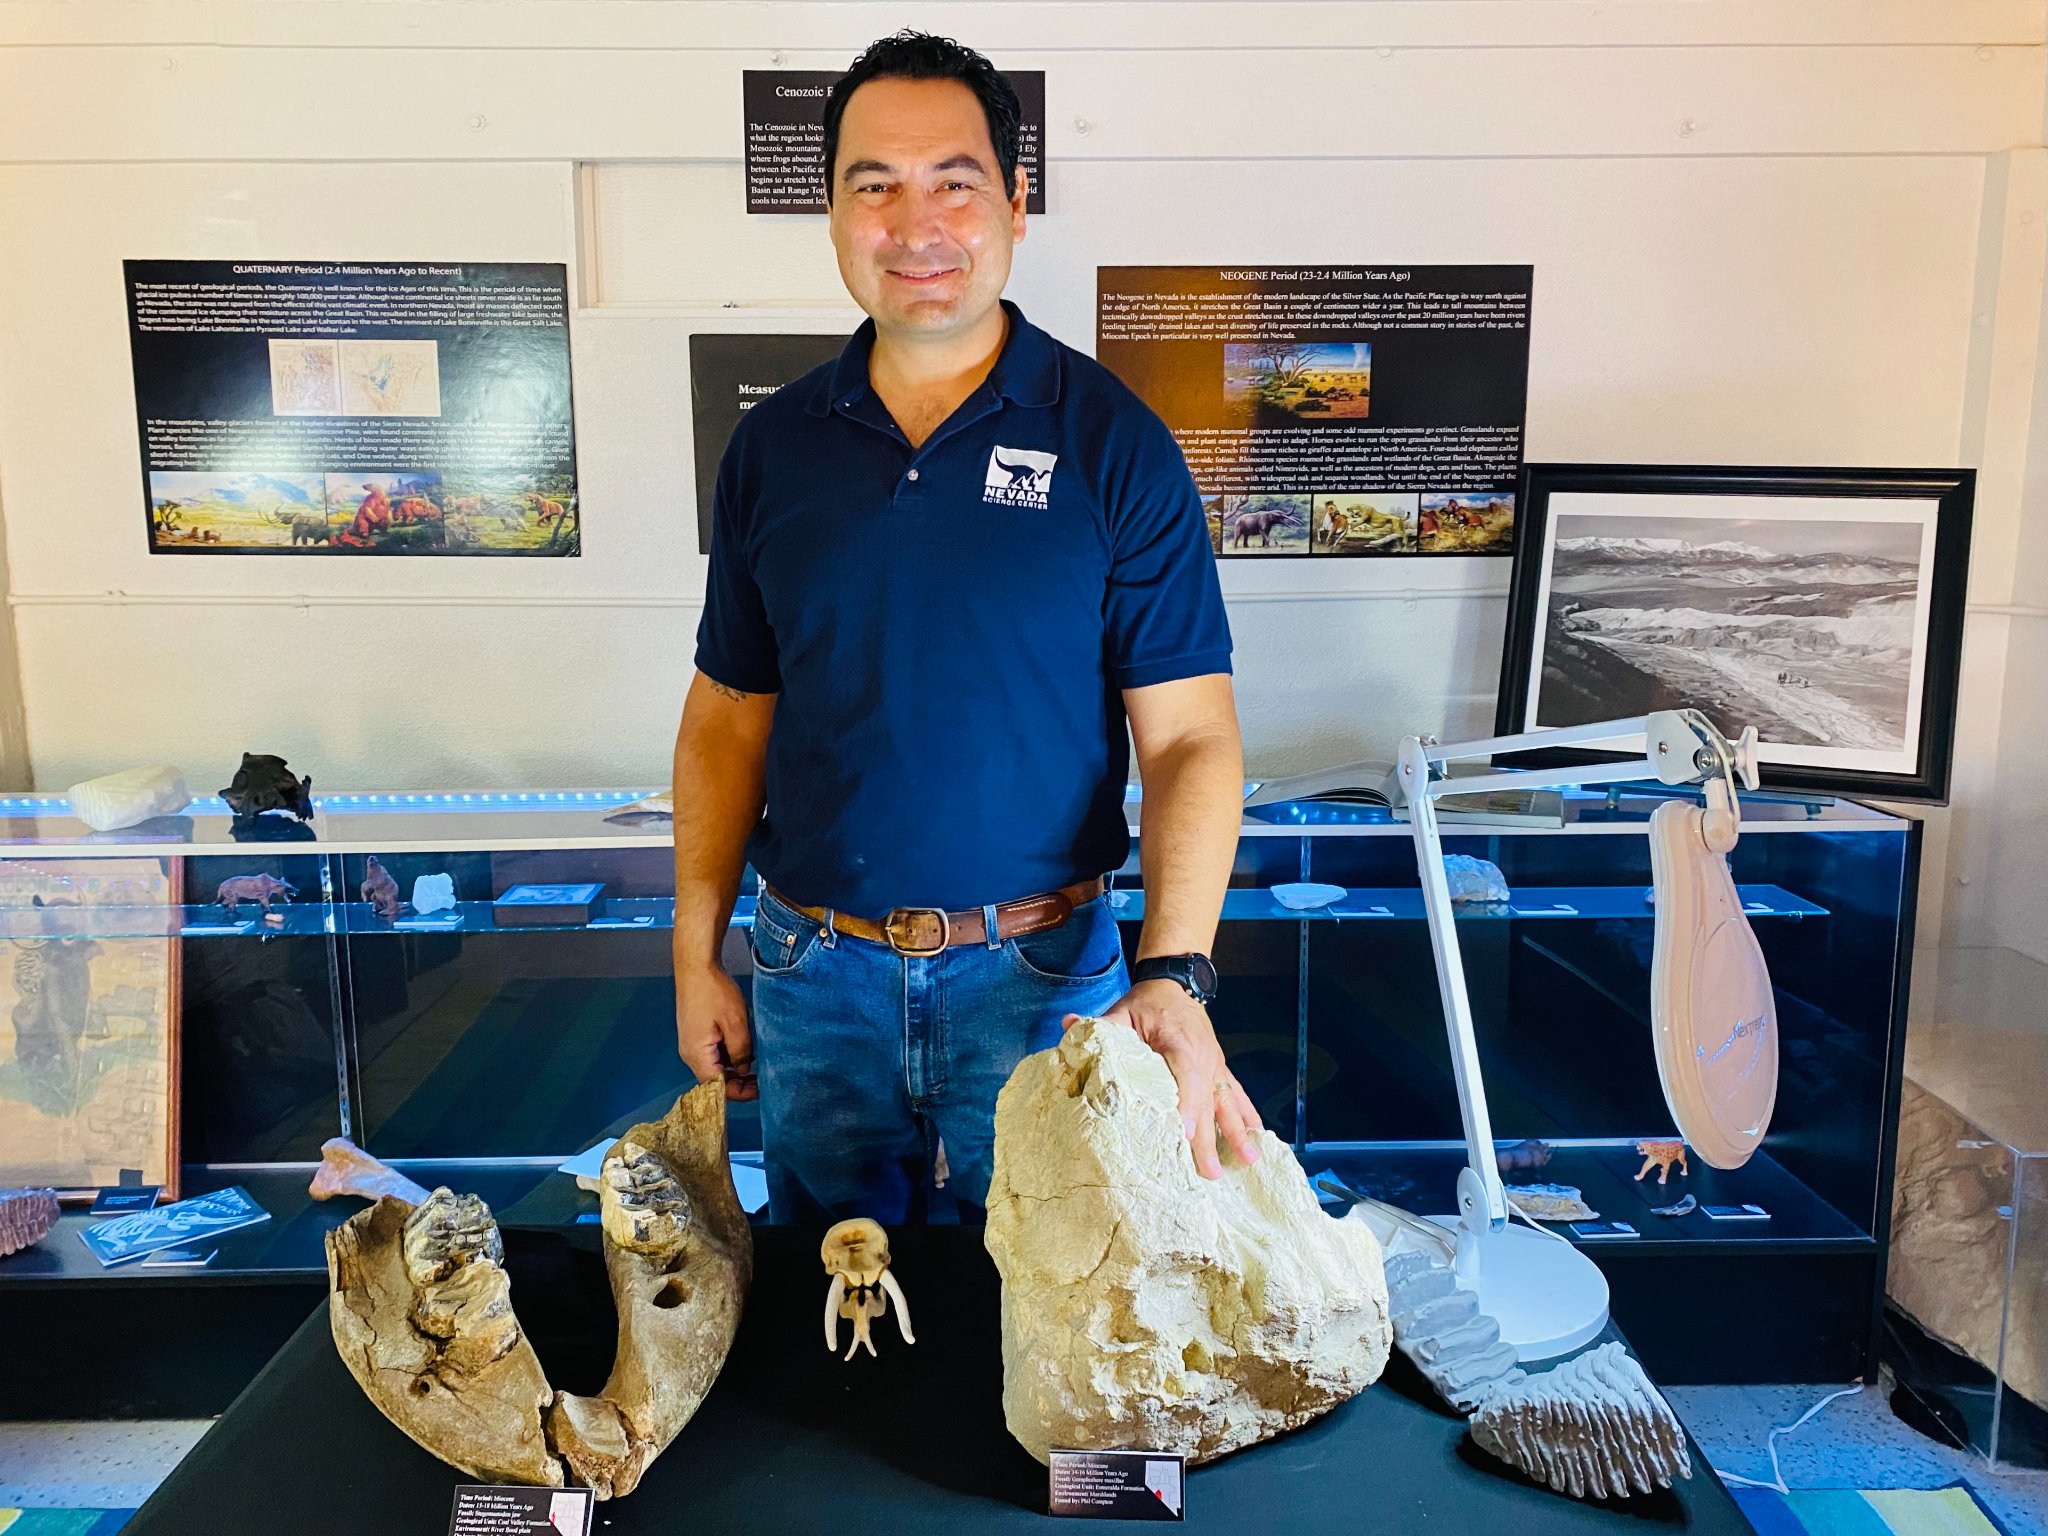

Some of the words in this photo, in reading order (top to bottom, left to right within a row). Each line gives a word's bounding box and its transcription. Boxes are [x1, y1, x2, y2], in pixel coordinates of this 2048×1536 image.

[776, 86, 824, 96] Cenozoic
[781, 134, 802, 143] region
[1025, 145, 1037, 153] Ely
[773, 155, 790, 164] frogs
[751, 176, 773, 185] begins
[788, 187, 809, 195] Range
[233, 265, 292, 274] QUATERNARY
[294, 265, 323, 274] Period
[324, 265, 340, 276] (2.4
[342, 266, 372, 274] Million
[374, 266, 396, 274] Years
[398, 266, 416, 276] Ago
[429, 266, 462, 276] Recent)
[1220, 272, 1268, 280] NEOGENE
[1270, 272, 1297, 280] Period
[1299, 272, 1329, 282] (23-2.4
[1332, 271, 1362, 280] Million
[1365, 271, 1387, 280] Years
[1389, 271, 1411, 282] Ago)
[1102, 323, 1125, 331] feeding
[1127, 322, 1157, 331] internally
[1229, 322, 1257, 331] diversity
[1279, 322, 1310, 331] preserved
[1352, 322, 1382, 330] Although
[1131, 332, 1151, 341] Epoch
[1160, 332, 1190, 341] particular
[1229, 332, 1261, 341] preserved
[738, 384, 784, 394] Measu
[1283, 427, 1311, 435] evolving
[1386, 427, 1424, 435] experiments
[1496, 426, 1519, 434] expand
[984, 486, 1047, 503] NEVADA
[982, 496, 1016, 506] SCIENCE
[1018, 500, 1048, 510] CENTER
